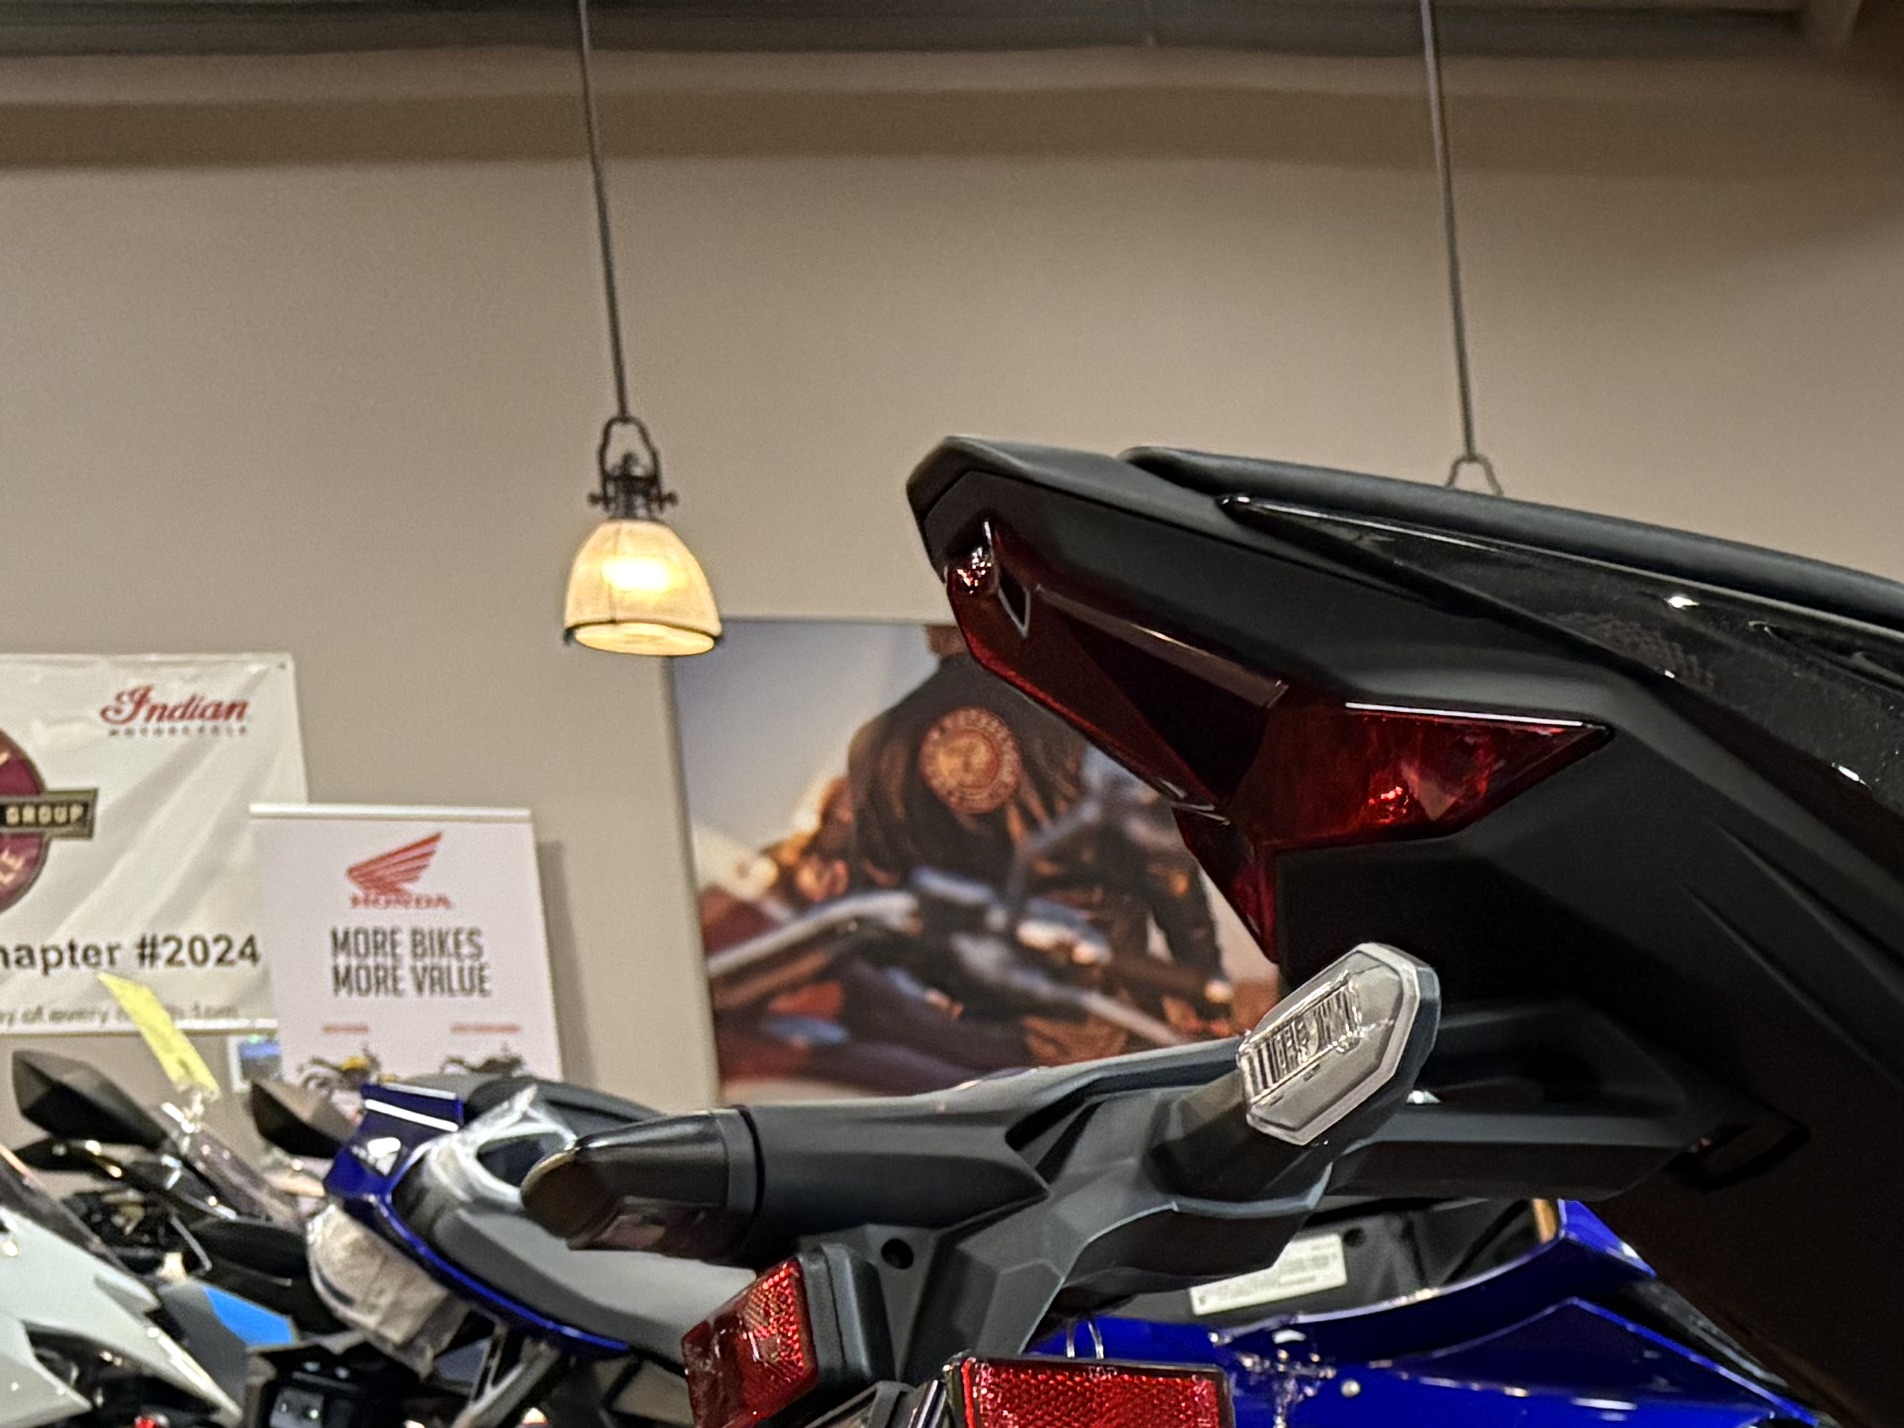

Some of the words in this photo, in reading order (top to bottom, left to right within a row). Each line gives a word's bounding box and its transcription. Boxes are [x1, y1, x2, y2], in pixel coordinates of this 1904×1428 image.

[100, 684, 250, 725] Indian
[5, 804, 84, 825] GROUP
[137, 933, 261, 968] #2024
[331, 927, 402, 960] MORE
[410, 926, 484, 961] BIKES
[332, 963, 404, 997] MORE
[410, 963, 492, 997] VALUE
